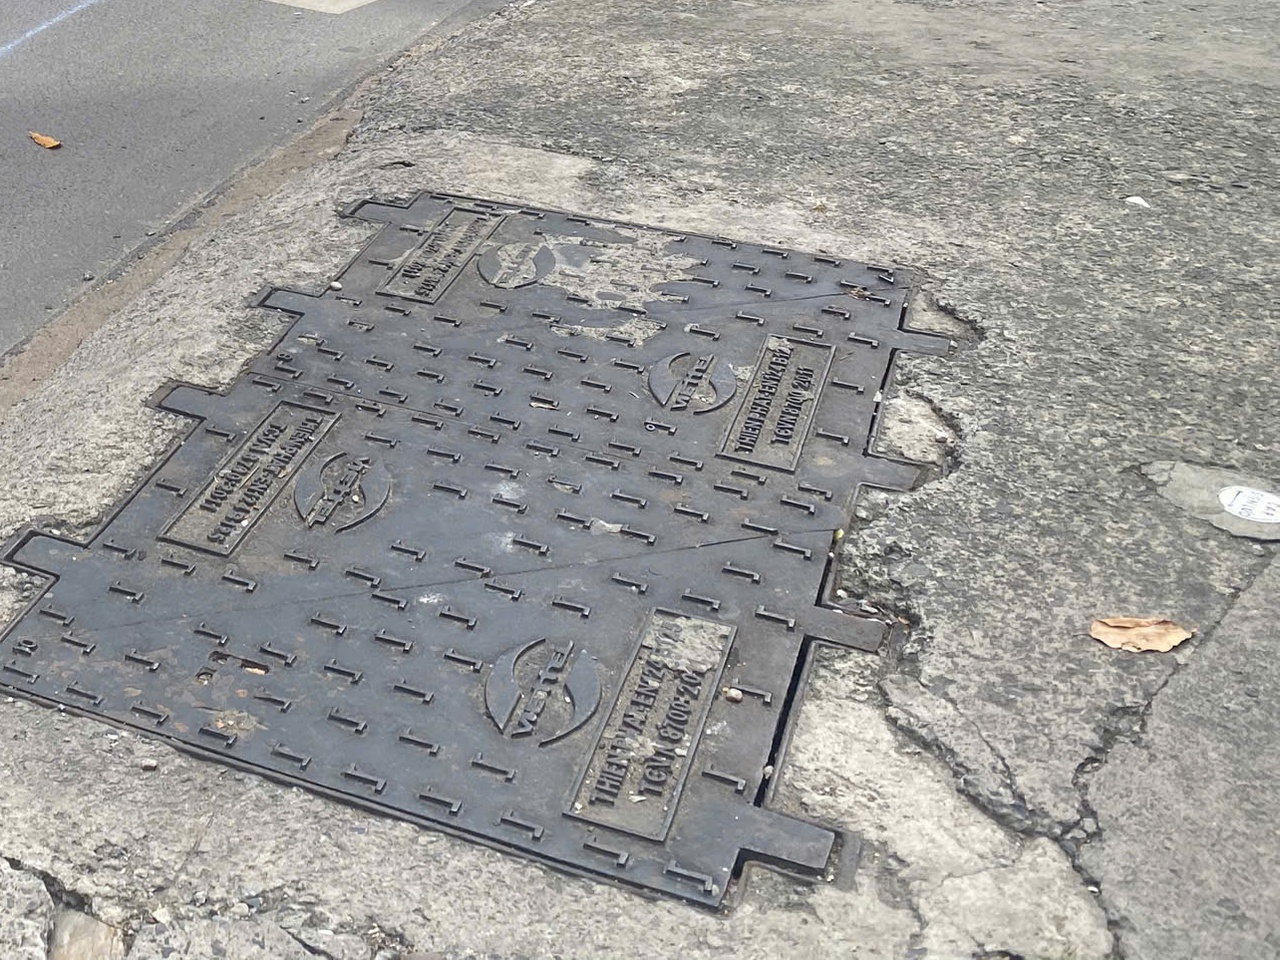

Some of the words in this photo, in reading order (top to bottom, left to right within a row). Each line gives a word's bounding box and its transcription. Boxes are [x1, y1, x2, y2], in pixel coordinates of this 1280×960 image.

[285, 414, 325, 447] THIEN
[733, 418, 764, 452] THIEN
[586, 750, 634, 809] THIEN
